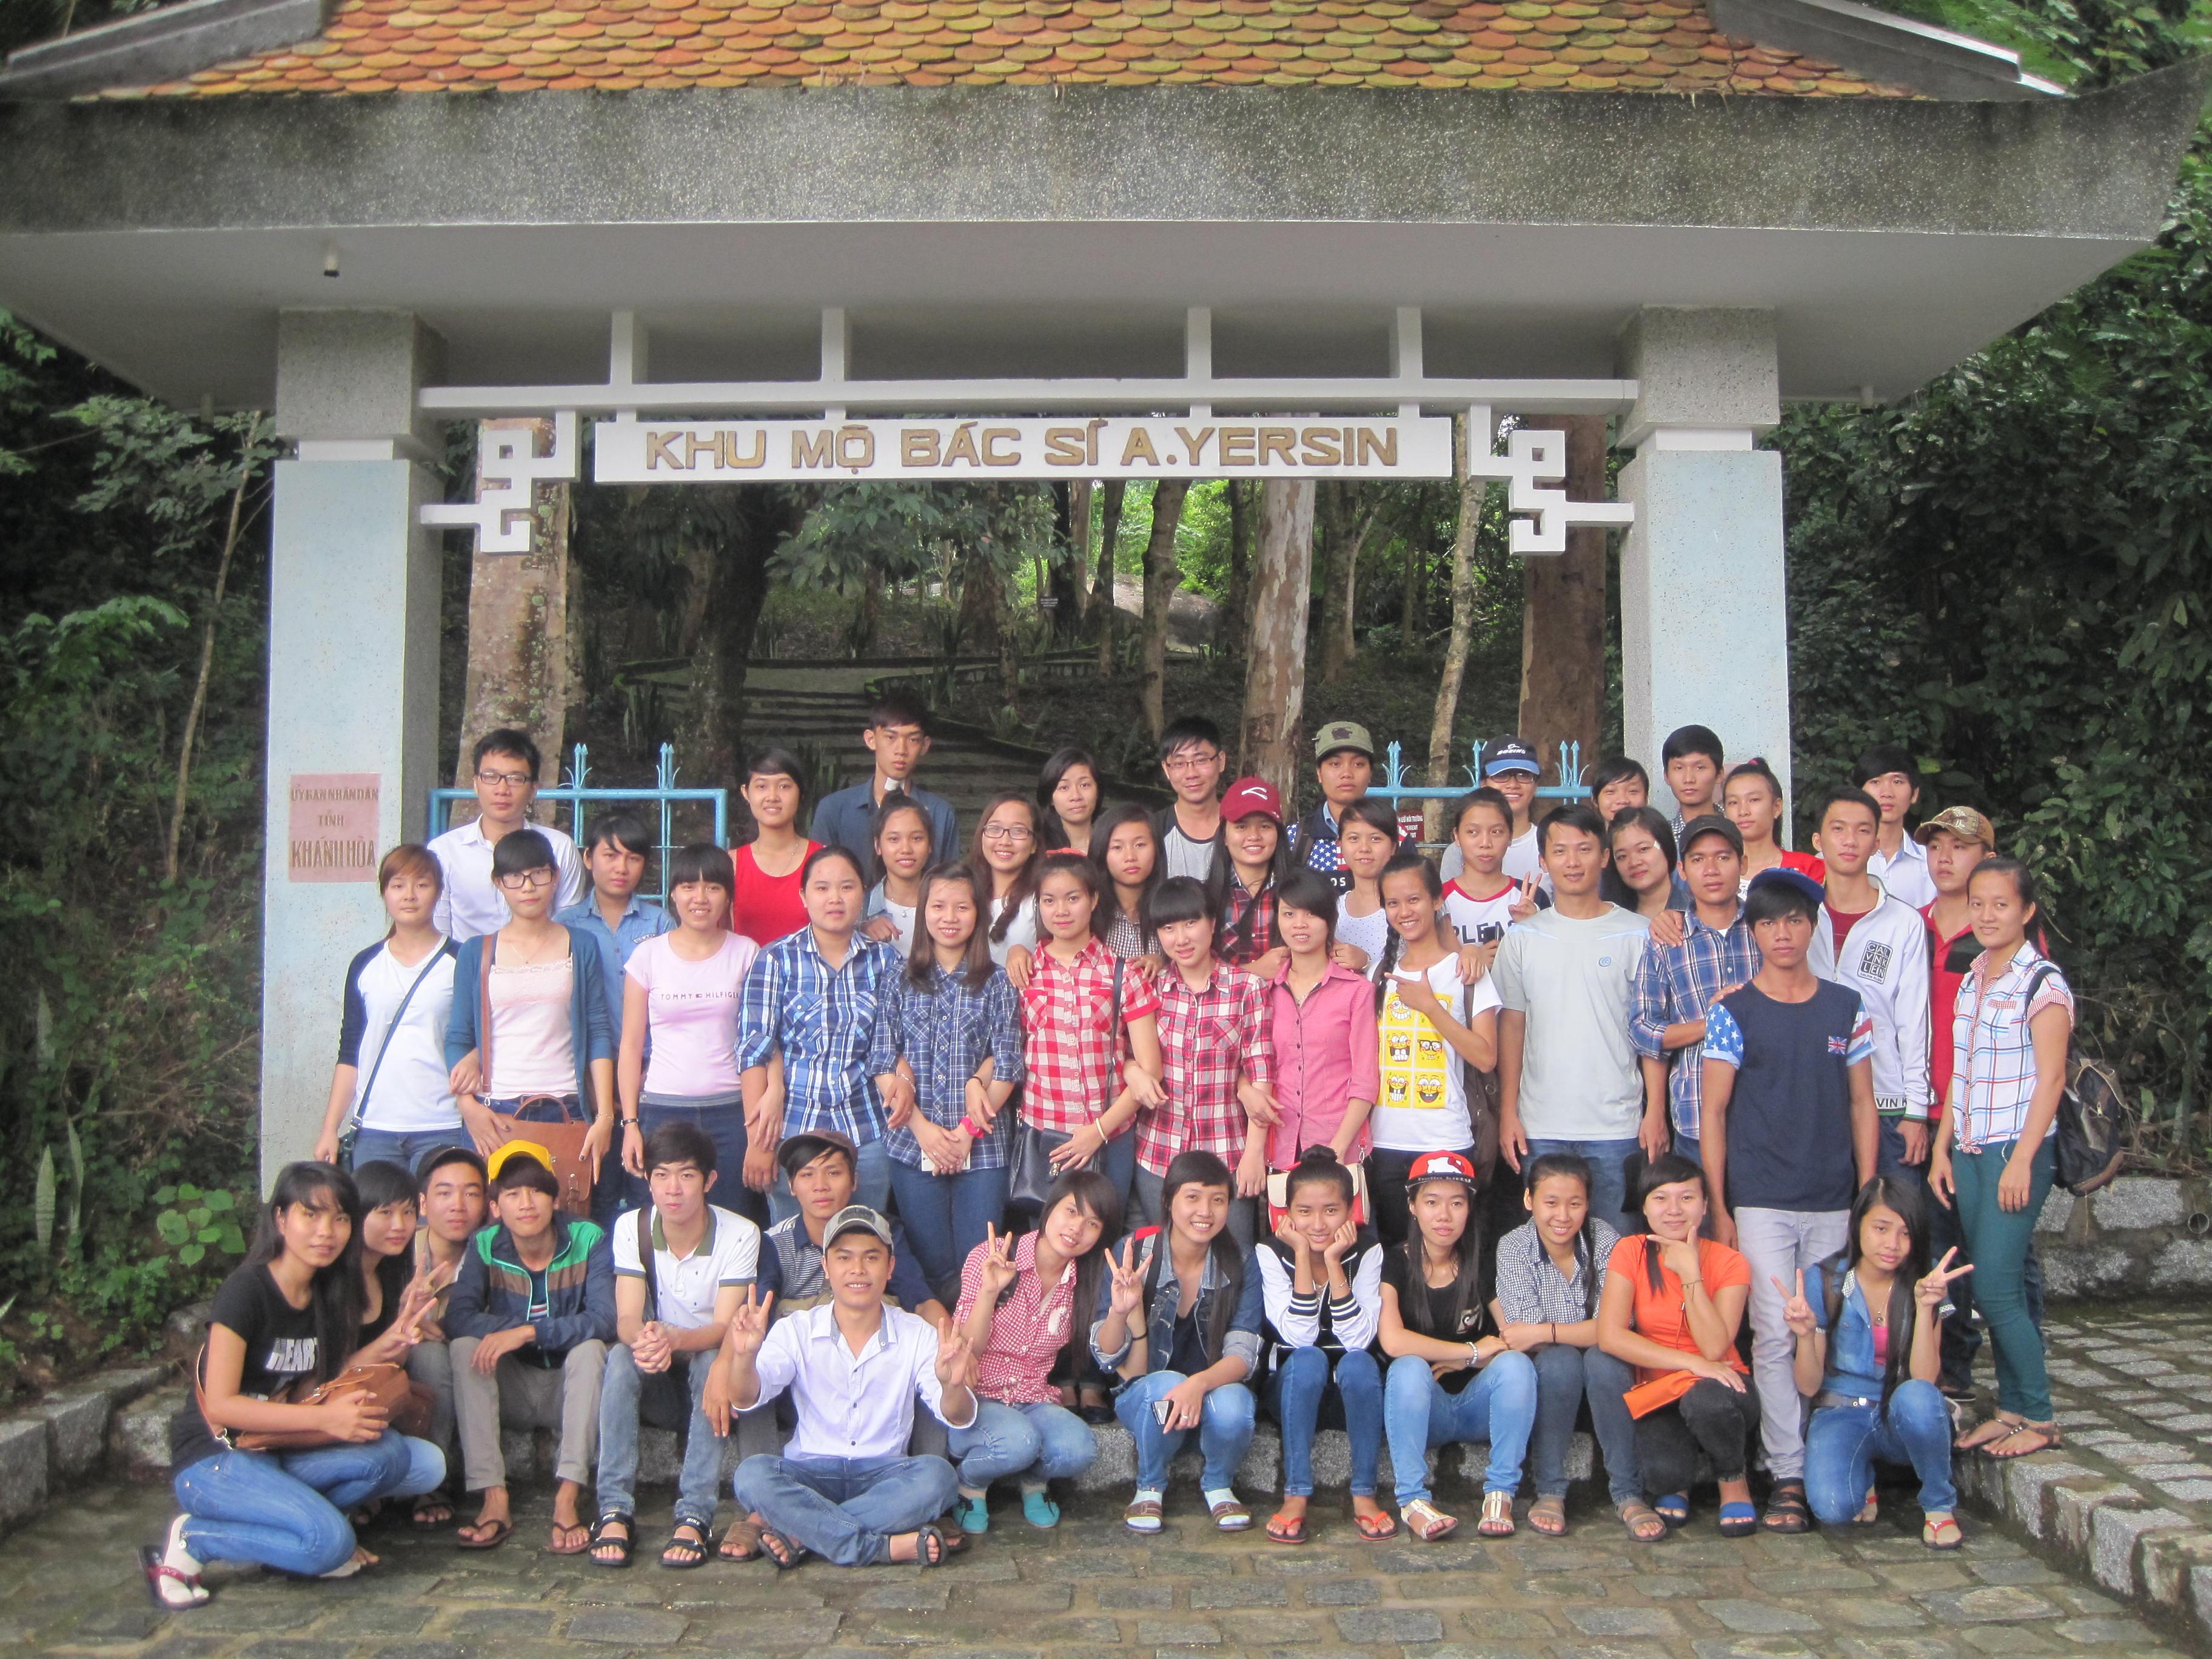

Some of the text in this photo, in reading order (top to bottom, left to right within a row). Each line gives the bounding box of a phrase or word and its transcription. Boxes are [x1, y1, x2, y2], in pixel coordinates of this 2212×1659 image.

[646, 430, 766, 470] KHU
[791, 424, 874, 474] MỘ
[900, 421, 1022, 468] BÁC
[1121, 427, 1398, 467] A.YERSIN
[292, 836, 376, 868] KHÁNH HÒA
